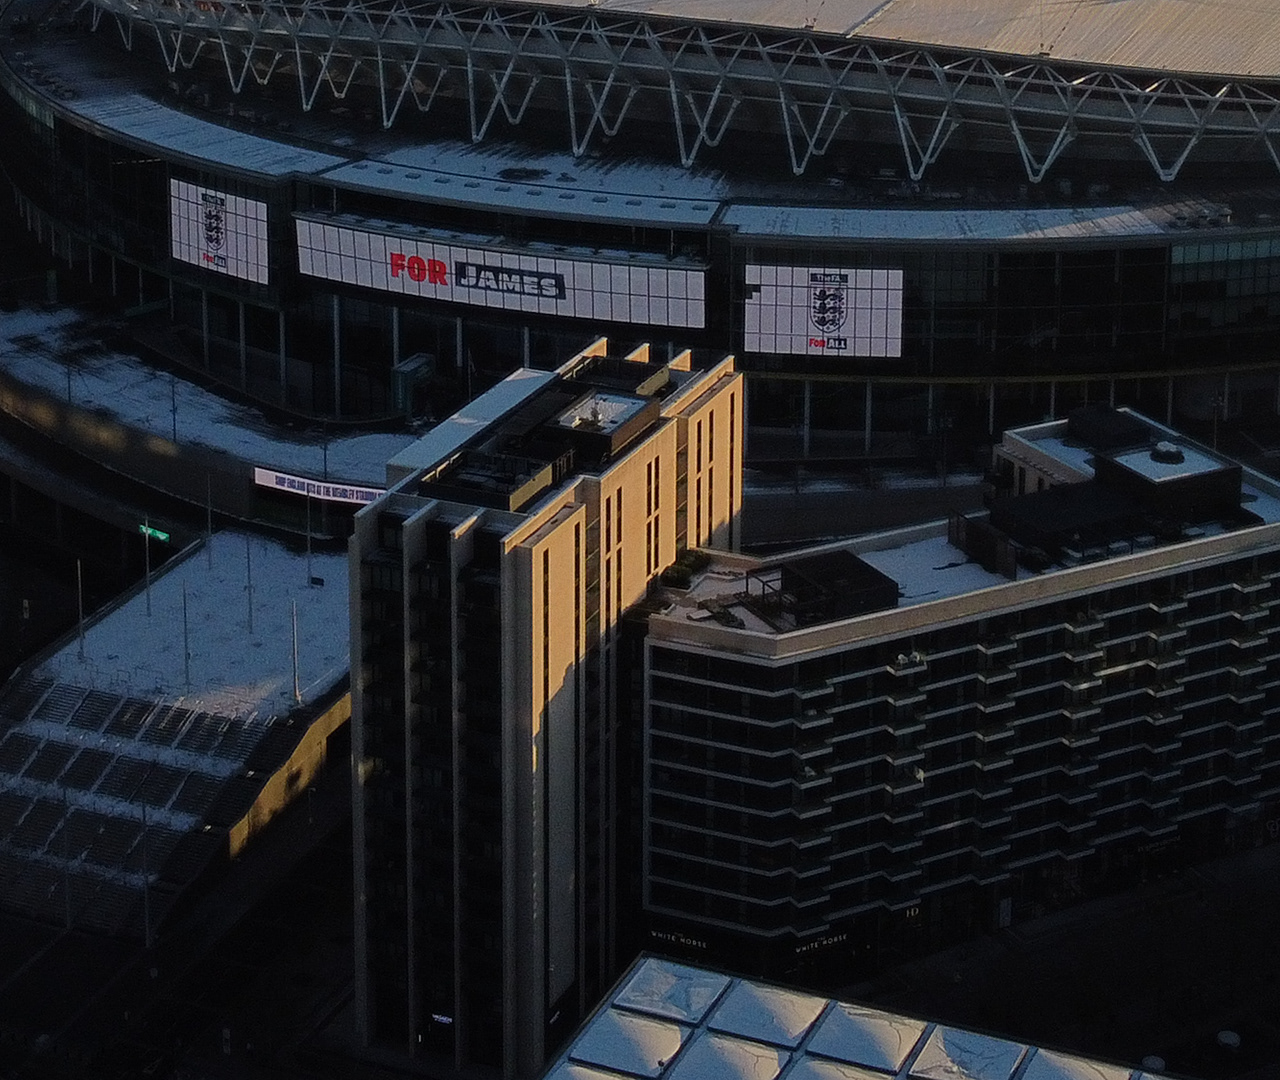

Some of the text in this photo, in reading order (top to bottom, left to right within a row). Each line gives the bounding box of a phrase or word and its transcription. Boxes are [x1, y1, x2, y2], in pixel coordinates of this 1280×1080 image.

[389, 251, 560, 298] FOR JAMES
[827, 338, 846, 349] ALL
[651, 930, 677, 942] WHITE
[680, 937, 707, 949] HORSE
[795, 941, 819, 953] WHITE
[822, 933, 847, 945] HORSE
